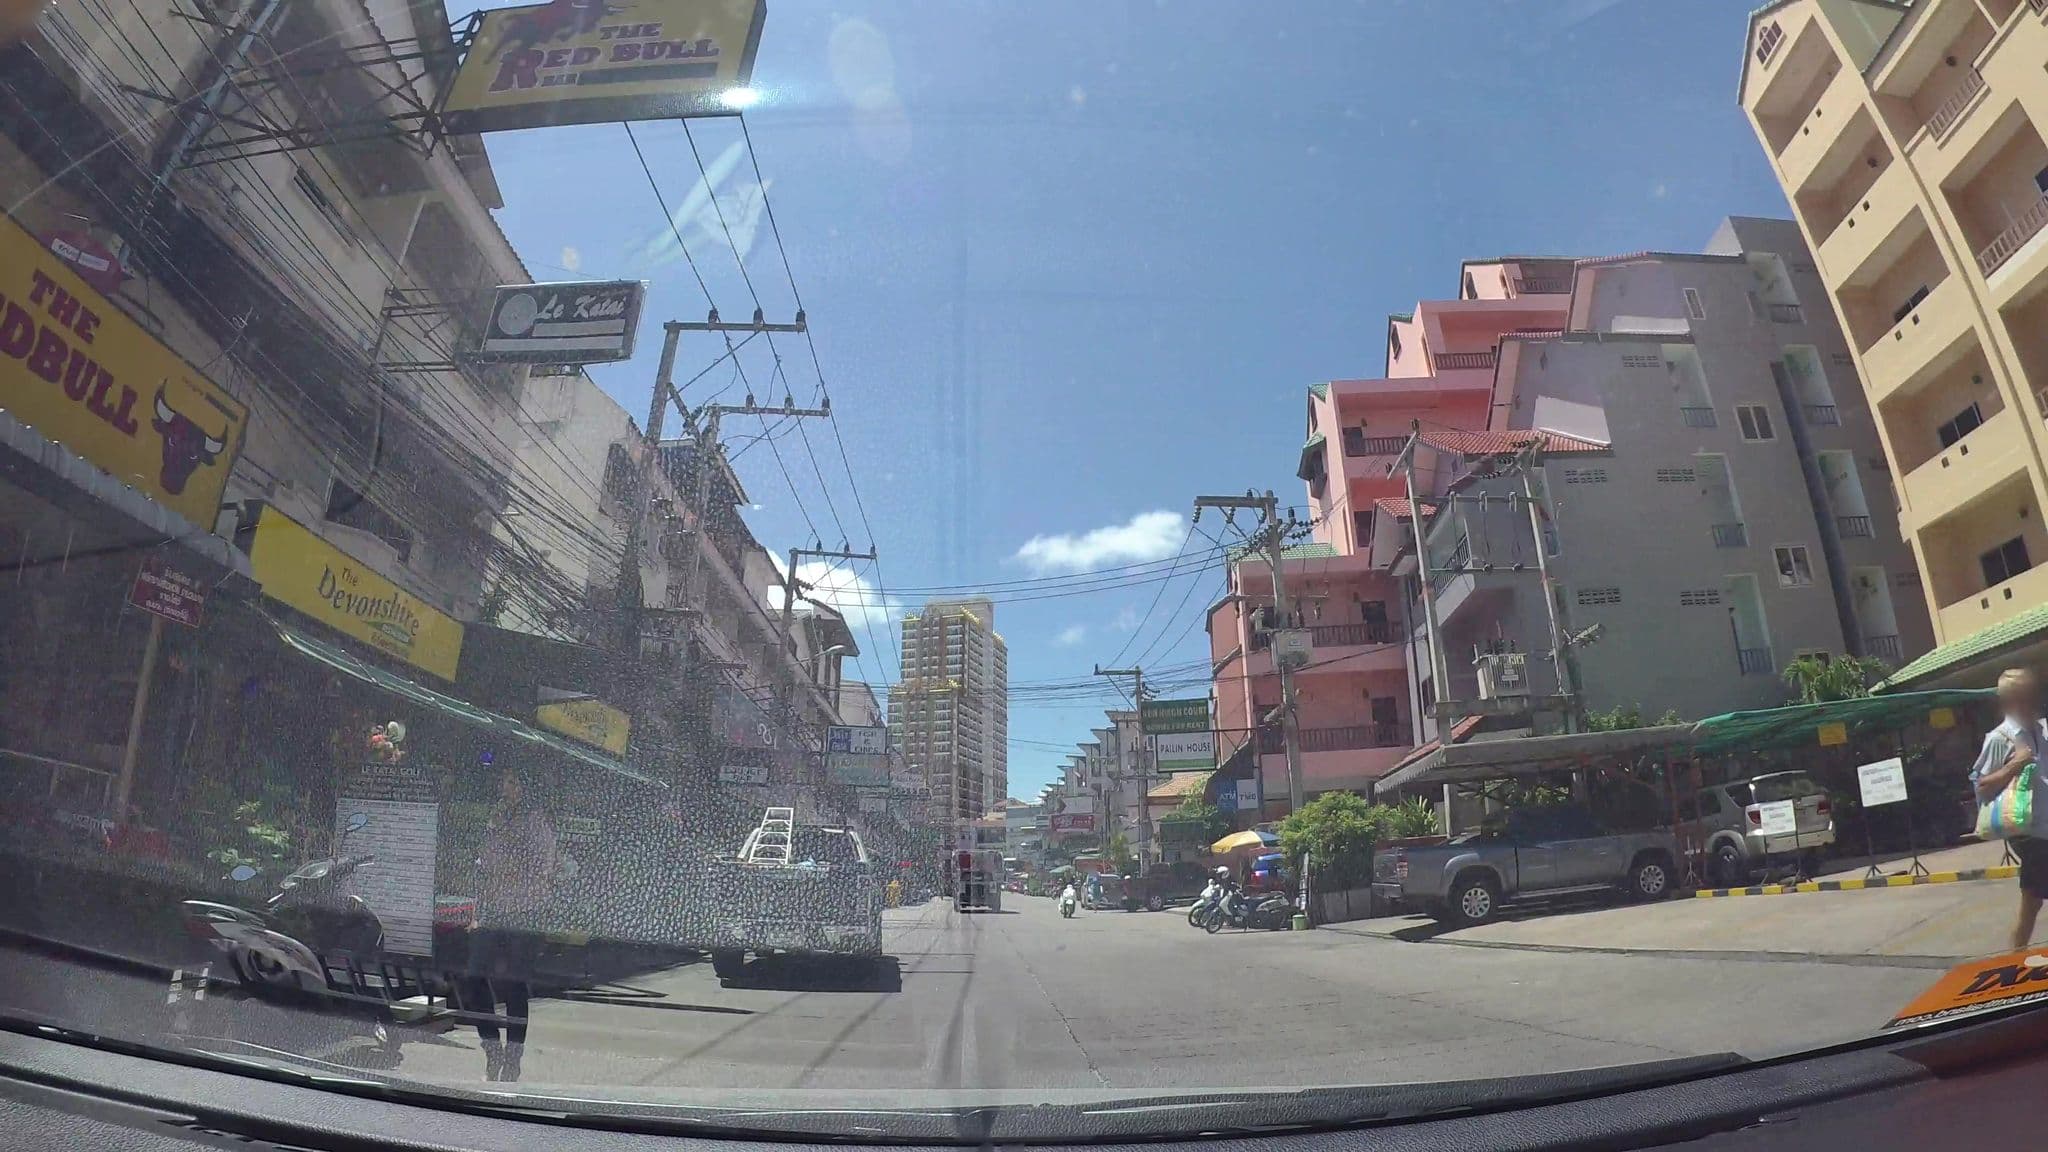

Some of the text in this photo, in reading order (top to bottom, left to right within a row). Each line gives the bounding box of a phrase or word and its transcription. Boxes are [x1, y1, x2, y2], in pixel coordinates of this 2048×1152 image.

[600, 23, 662, 40] THE
[488, 46, 601, 91] RED
[608, 39, 719, 62] BULL
[29, 268, 100, 345] THE
[534, 294, 565, 320] Le
[0, 293, 138, 438] DBULL
[341, 567, 359, 586] The
[317, 563, 420, 636] Devonshire
[1160, 742, 1211, 753] PAILIN HOUSE
